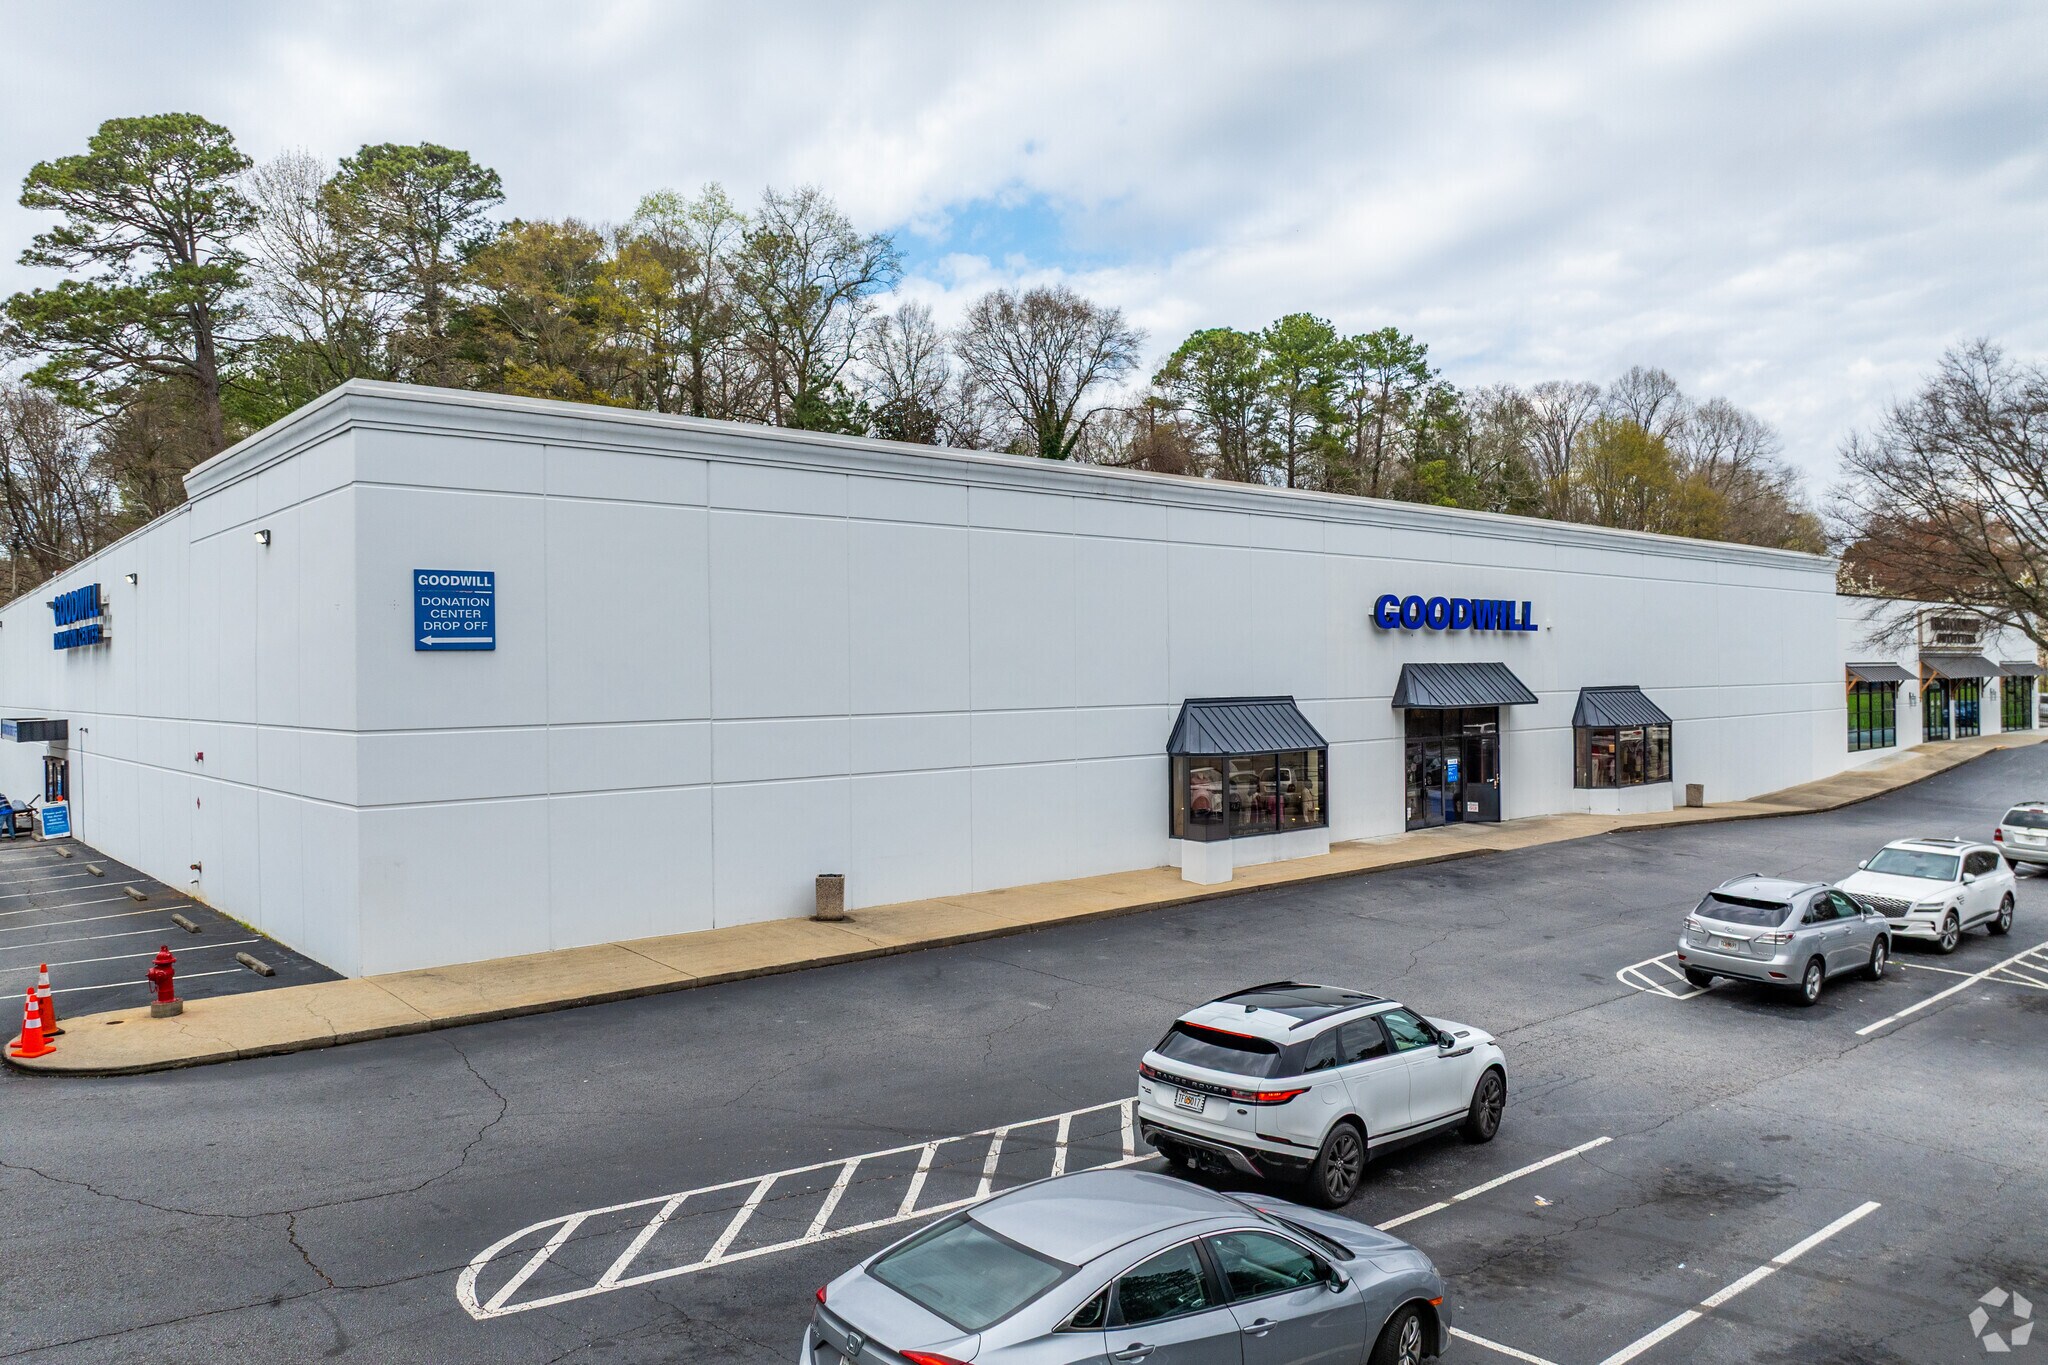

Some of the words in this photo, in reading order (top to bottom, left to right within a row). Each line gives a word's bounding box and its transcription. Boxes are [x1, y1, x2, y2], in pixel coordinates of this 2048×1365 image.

[418, 574, 492, 587] GOODWILL
[54, 583, 99, 627] GOODWILL
[421, 596, 490, 607] DONATION
[430, 609, 481, 619] CENTER
[1374, 593, 1539, 632] GOODWILL
[423, 621, 460, 631] DROP
[463, 621, 488, 631] OFF
[1156, 1071, 1187, 1084] RANGE
[1191, 1081, 1228, 1094] ROVER
